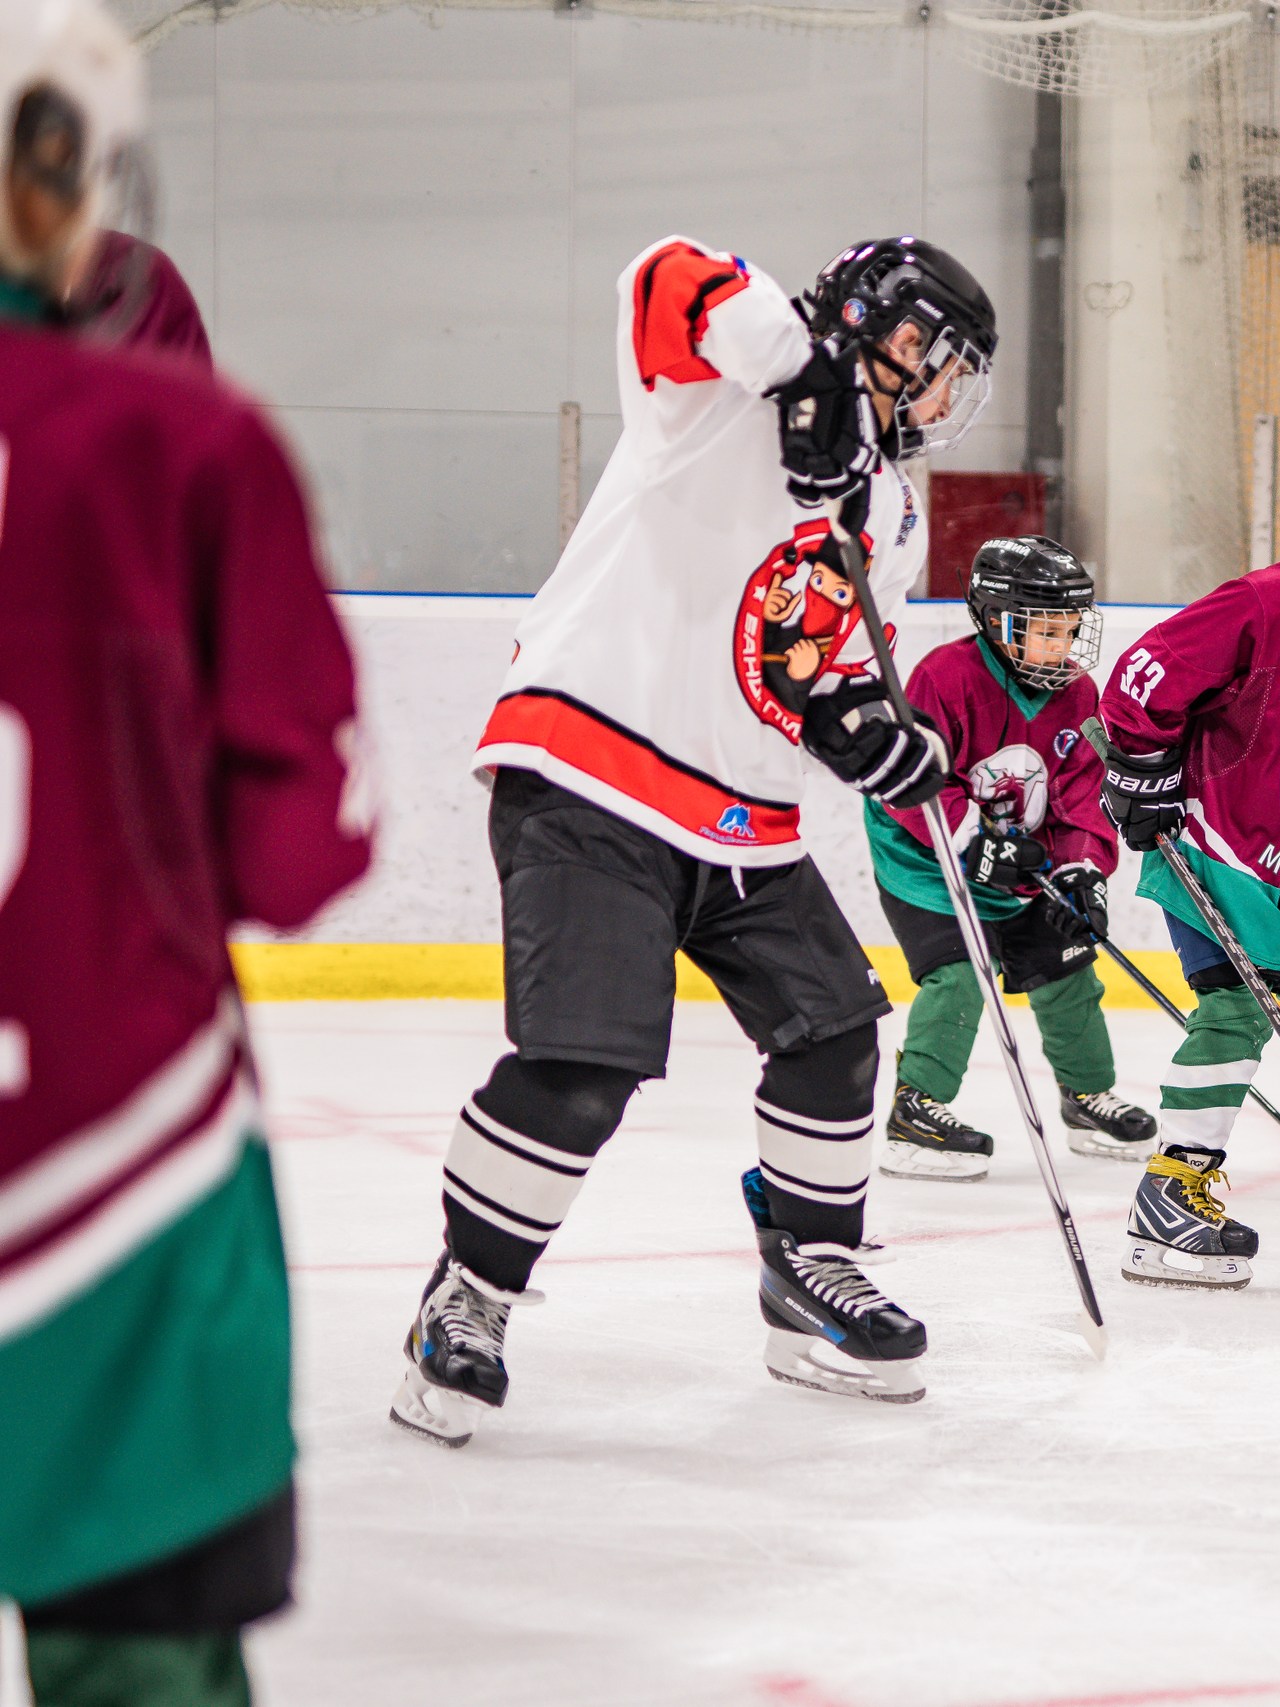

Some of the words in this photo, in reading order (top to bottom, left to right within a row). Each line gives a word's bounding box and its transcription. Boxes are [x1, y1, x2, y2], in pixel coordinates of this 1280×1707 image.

[743, 612, 763, 702] БАНД
[1120, 647, 1166, 709] 33
[975, 838, 997, 883] UER
[784, 1296, 825, 1329] BAUER
